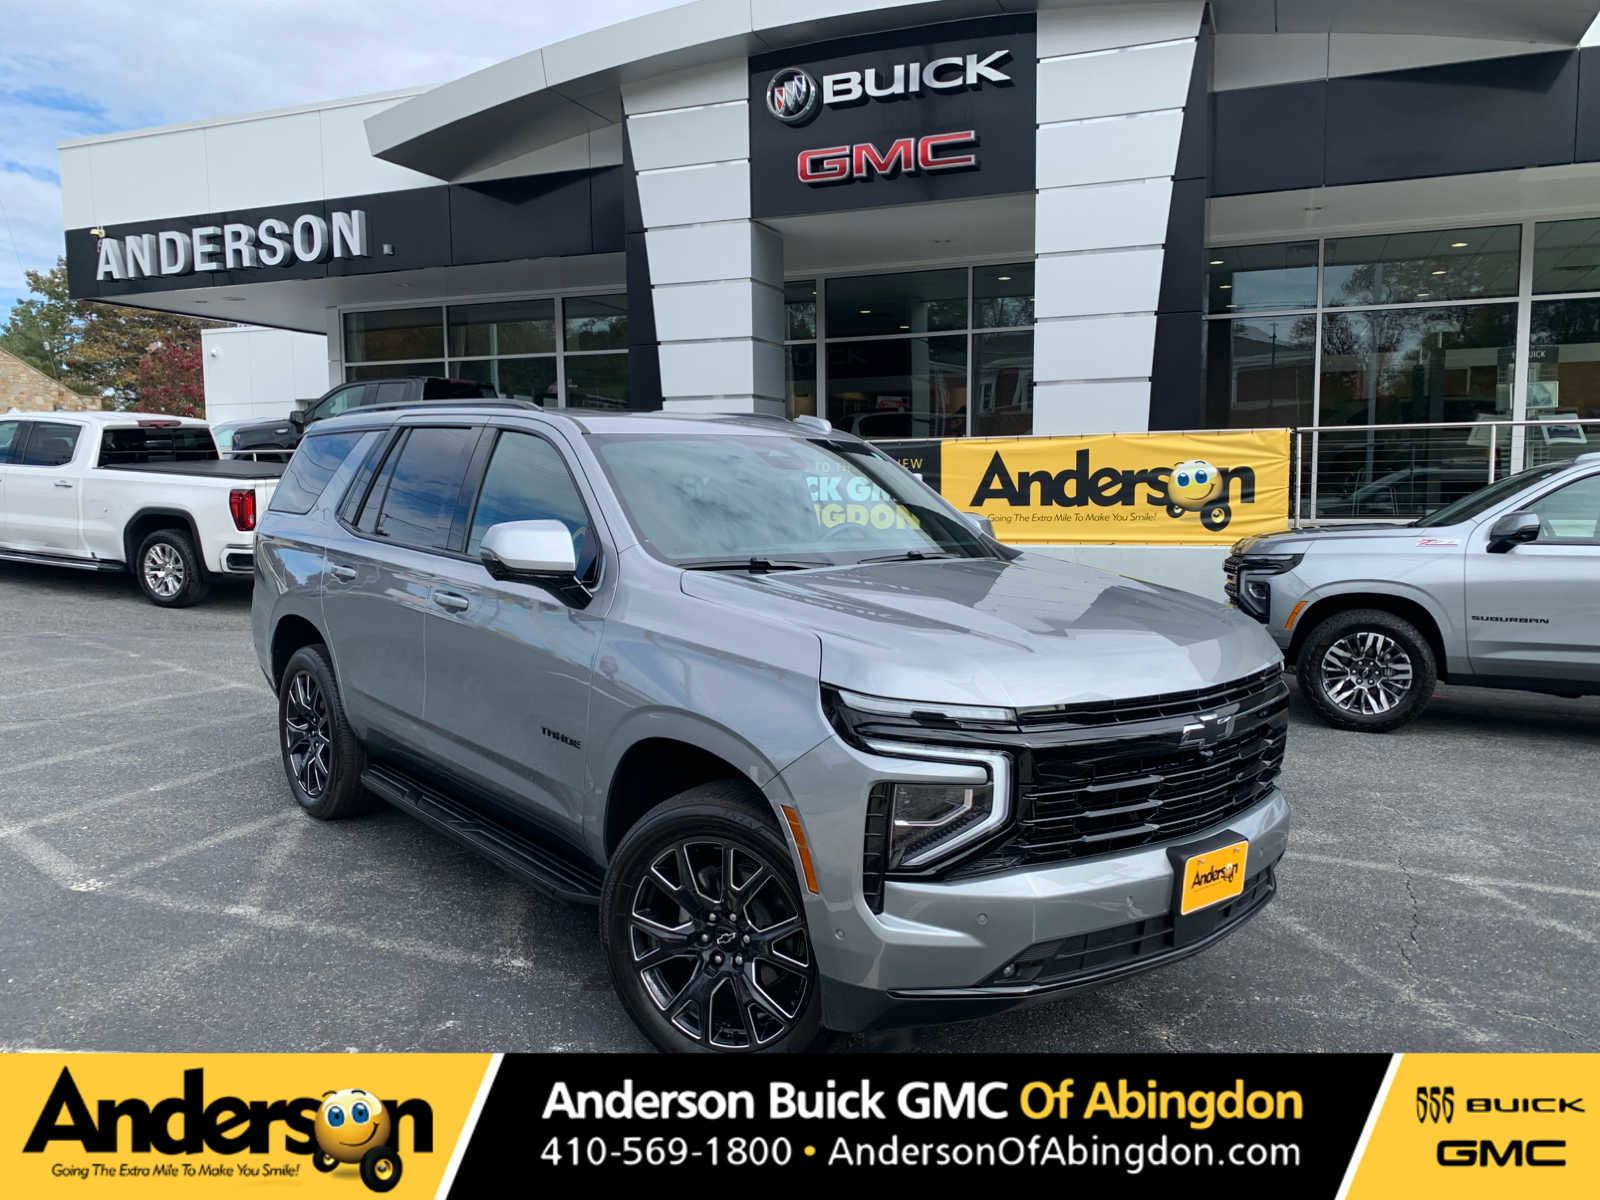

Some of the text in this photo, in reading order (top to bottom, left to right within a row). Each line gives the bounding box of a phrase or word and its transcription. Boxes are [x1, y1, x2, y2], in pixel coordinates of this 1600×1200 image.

[823, 50, 1011, 104] BUICK
[797, 130, 975, 183] GMC
[96, 209, 367, 281] ANDERSON
[969, 449, 1256, 508] Anderson
[1471, 615, 1550, 624] SUBURBAN
